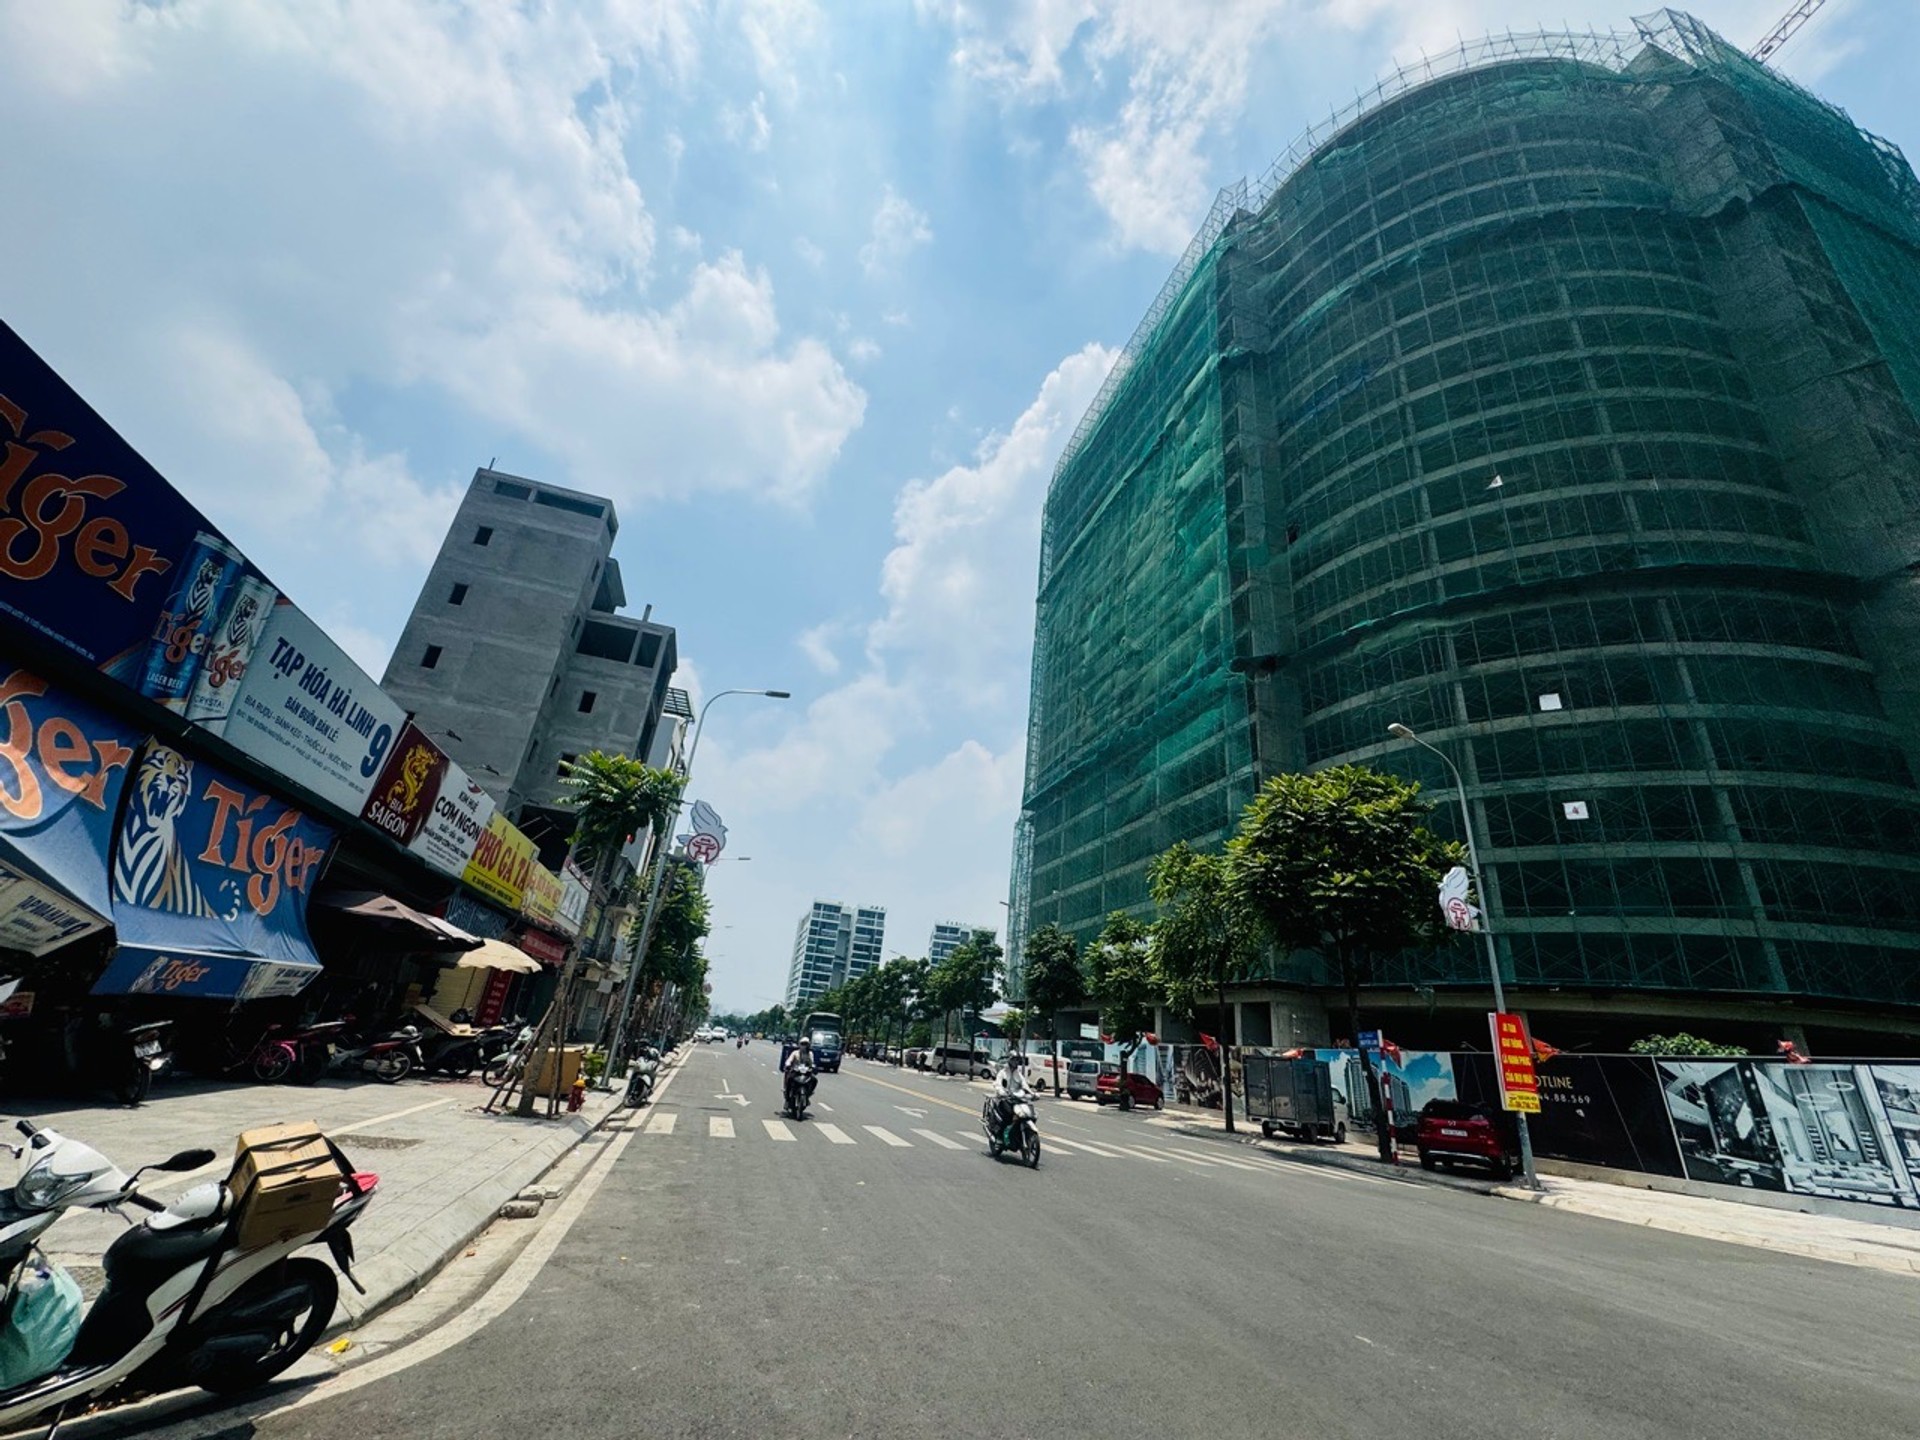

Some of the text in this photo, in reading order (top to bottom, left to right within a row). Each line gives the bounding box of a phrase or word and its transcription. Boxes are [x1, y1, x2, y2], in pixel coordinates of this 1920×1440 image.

[0, 393, 172, 602] iger
[152, 611, 211, 663] Tiger
[203, 644, 247, 688] iger
[268, 636, 376, 738] TẠP HÓA HÀ LINH
[359, 723, 392, 778] 9
[367, 800, 408, 837] SAIGON
[389, 797, 402, 813] BIA
[434, 795, 460, 824] CƠM
[454, 811, 482, 841] NGON
[199, 780, 325, 916] Tiger
[499, 843, 520, 884] GÀ
[513, 859, 532, 893] TA
[158, 958, 210, 990] Tiger
[1535, 1076, 1573, 1089] OTLINE
